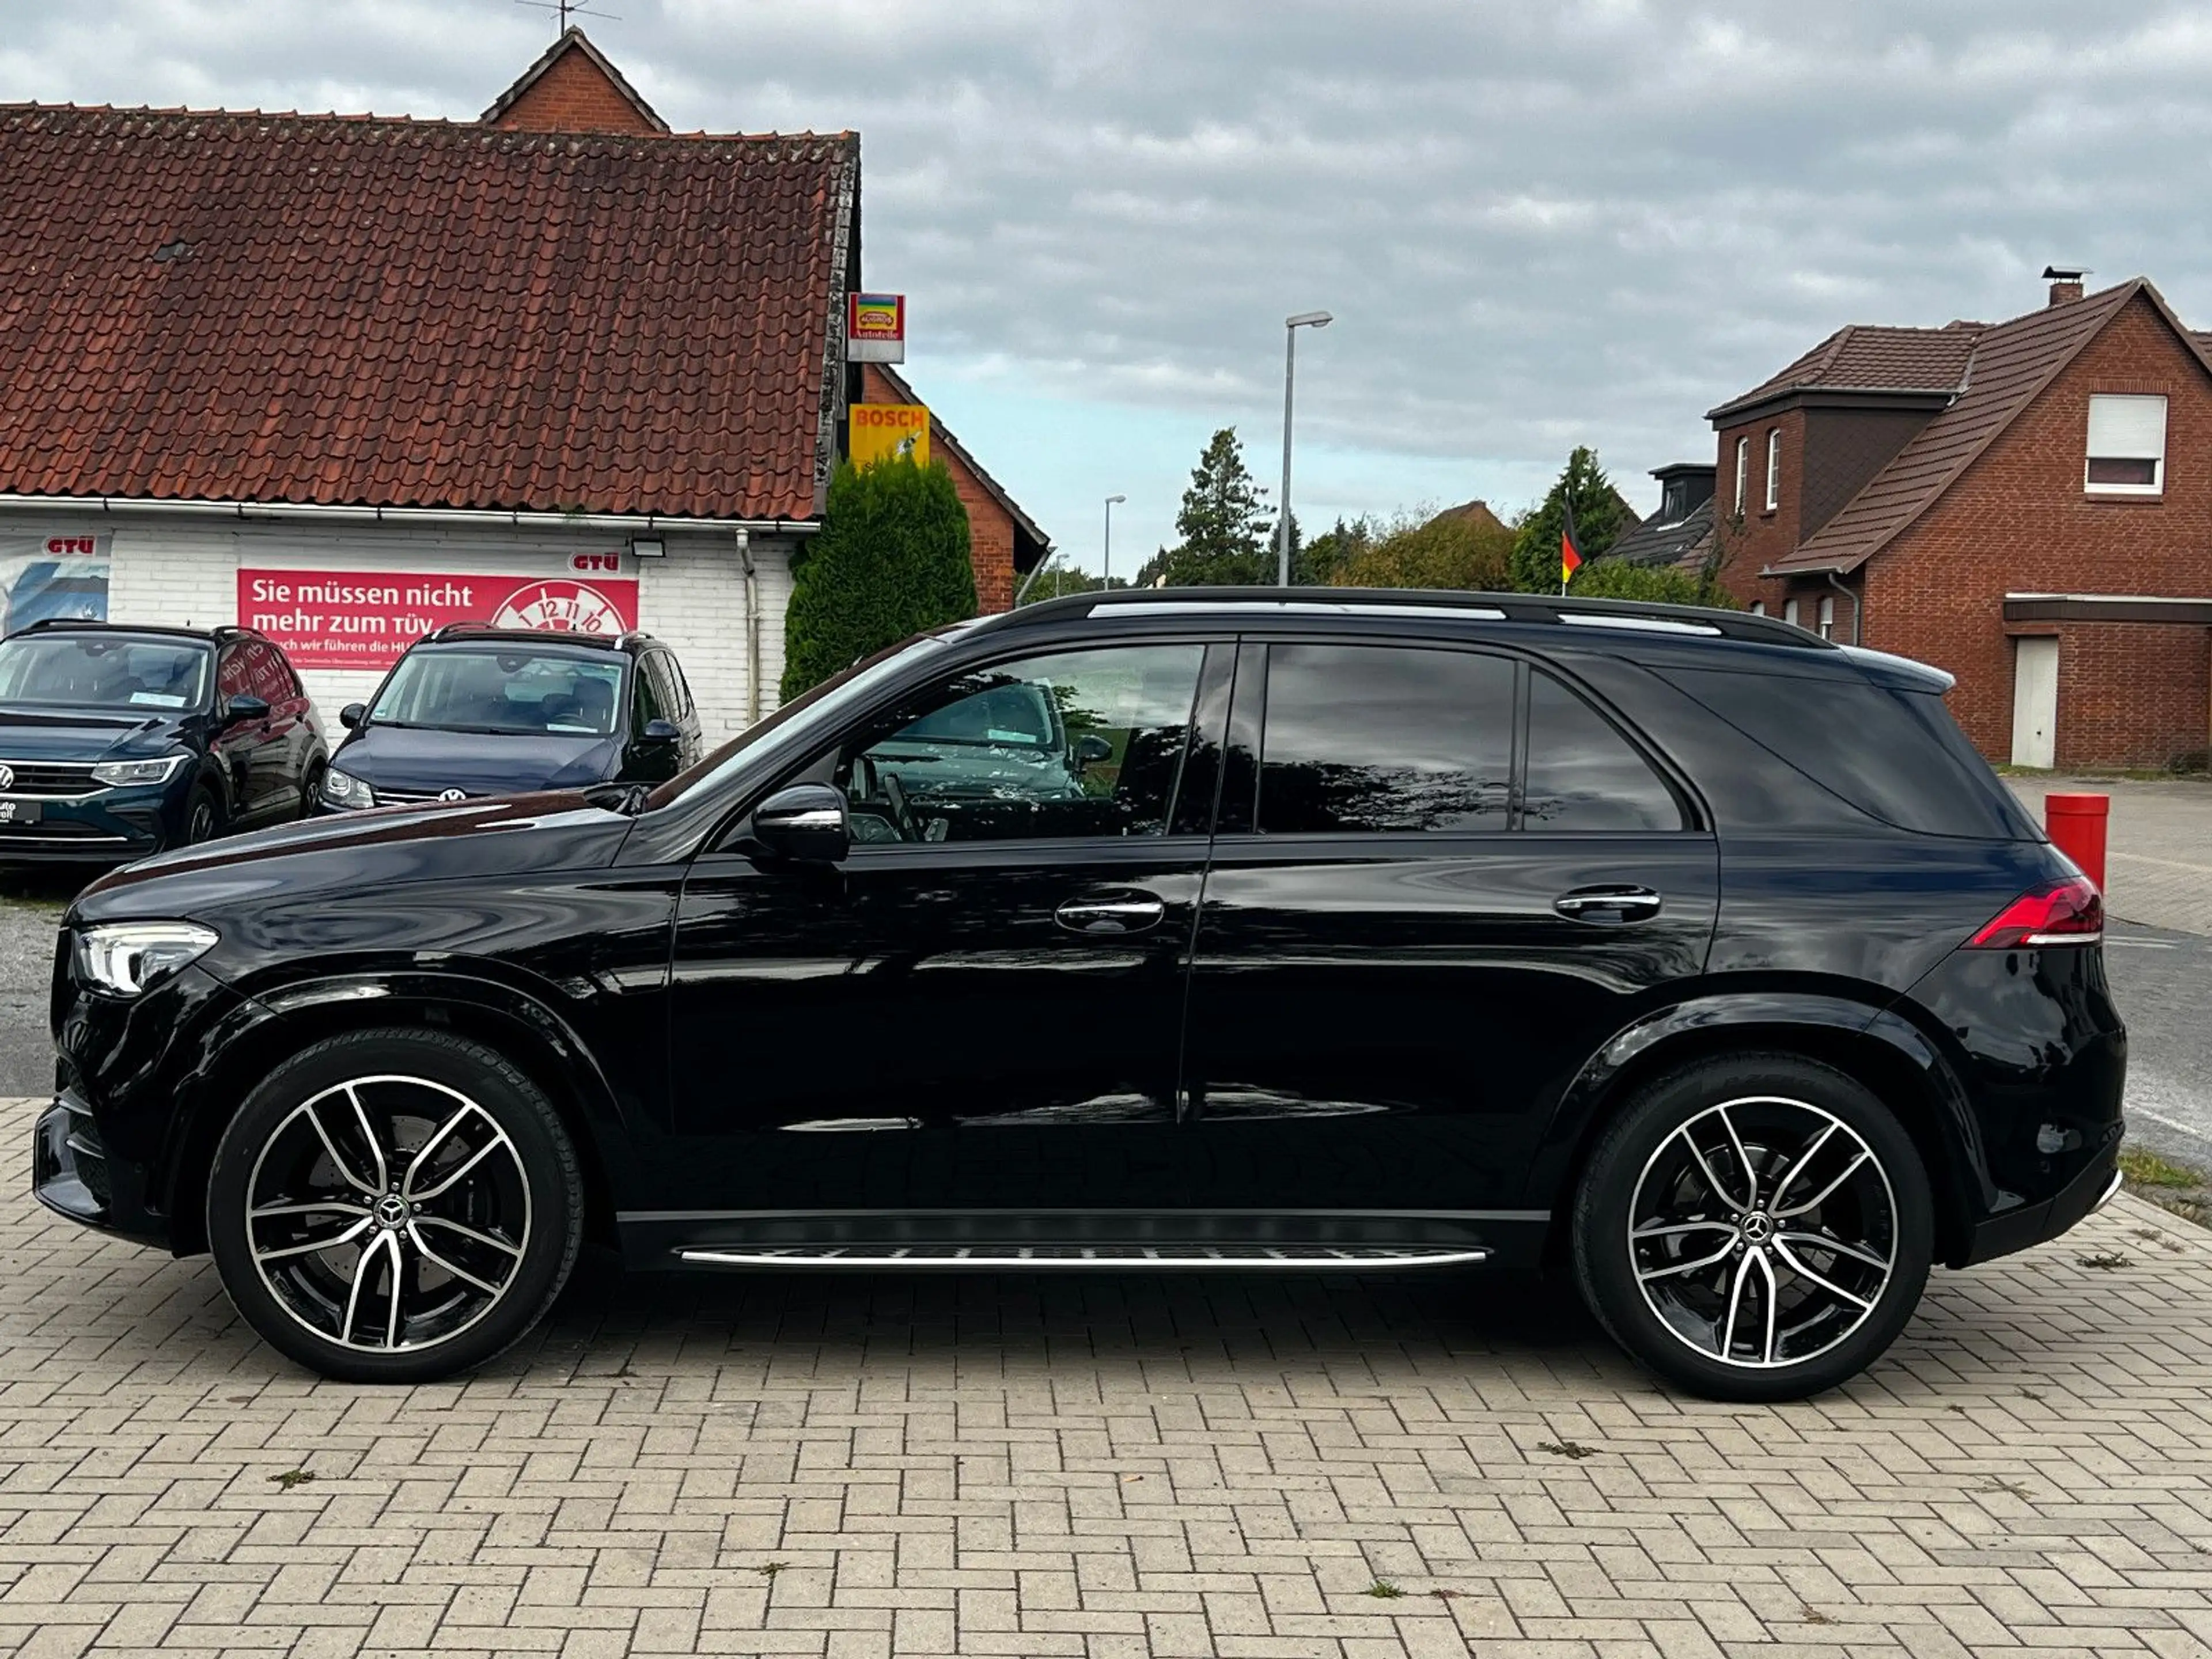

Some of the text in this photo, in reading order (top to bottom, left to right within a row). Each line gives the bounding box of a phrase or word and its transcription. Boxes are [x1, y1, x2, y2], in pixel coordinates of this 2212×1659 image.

[855, 329, 899, 340] Autoteile
[856, 410, 924, 427] BOSCH
[48, 535, 94, 554] GTÜ
[574, 552, 619, 571] GTÜ
[252, 579, 473, 607] Sie müssen nicht
[252, 608, 434, 635] mehr zum TÜV
[538, 601, 559, 619] 12
[566, 601, 579, 619] 11
[581, 612, 603, 632] 10
[300, 639, 321, 651] wir
[324, 639, 366, 652] führen
[369, 641, 388, 652] die
